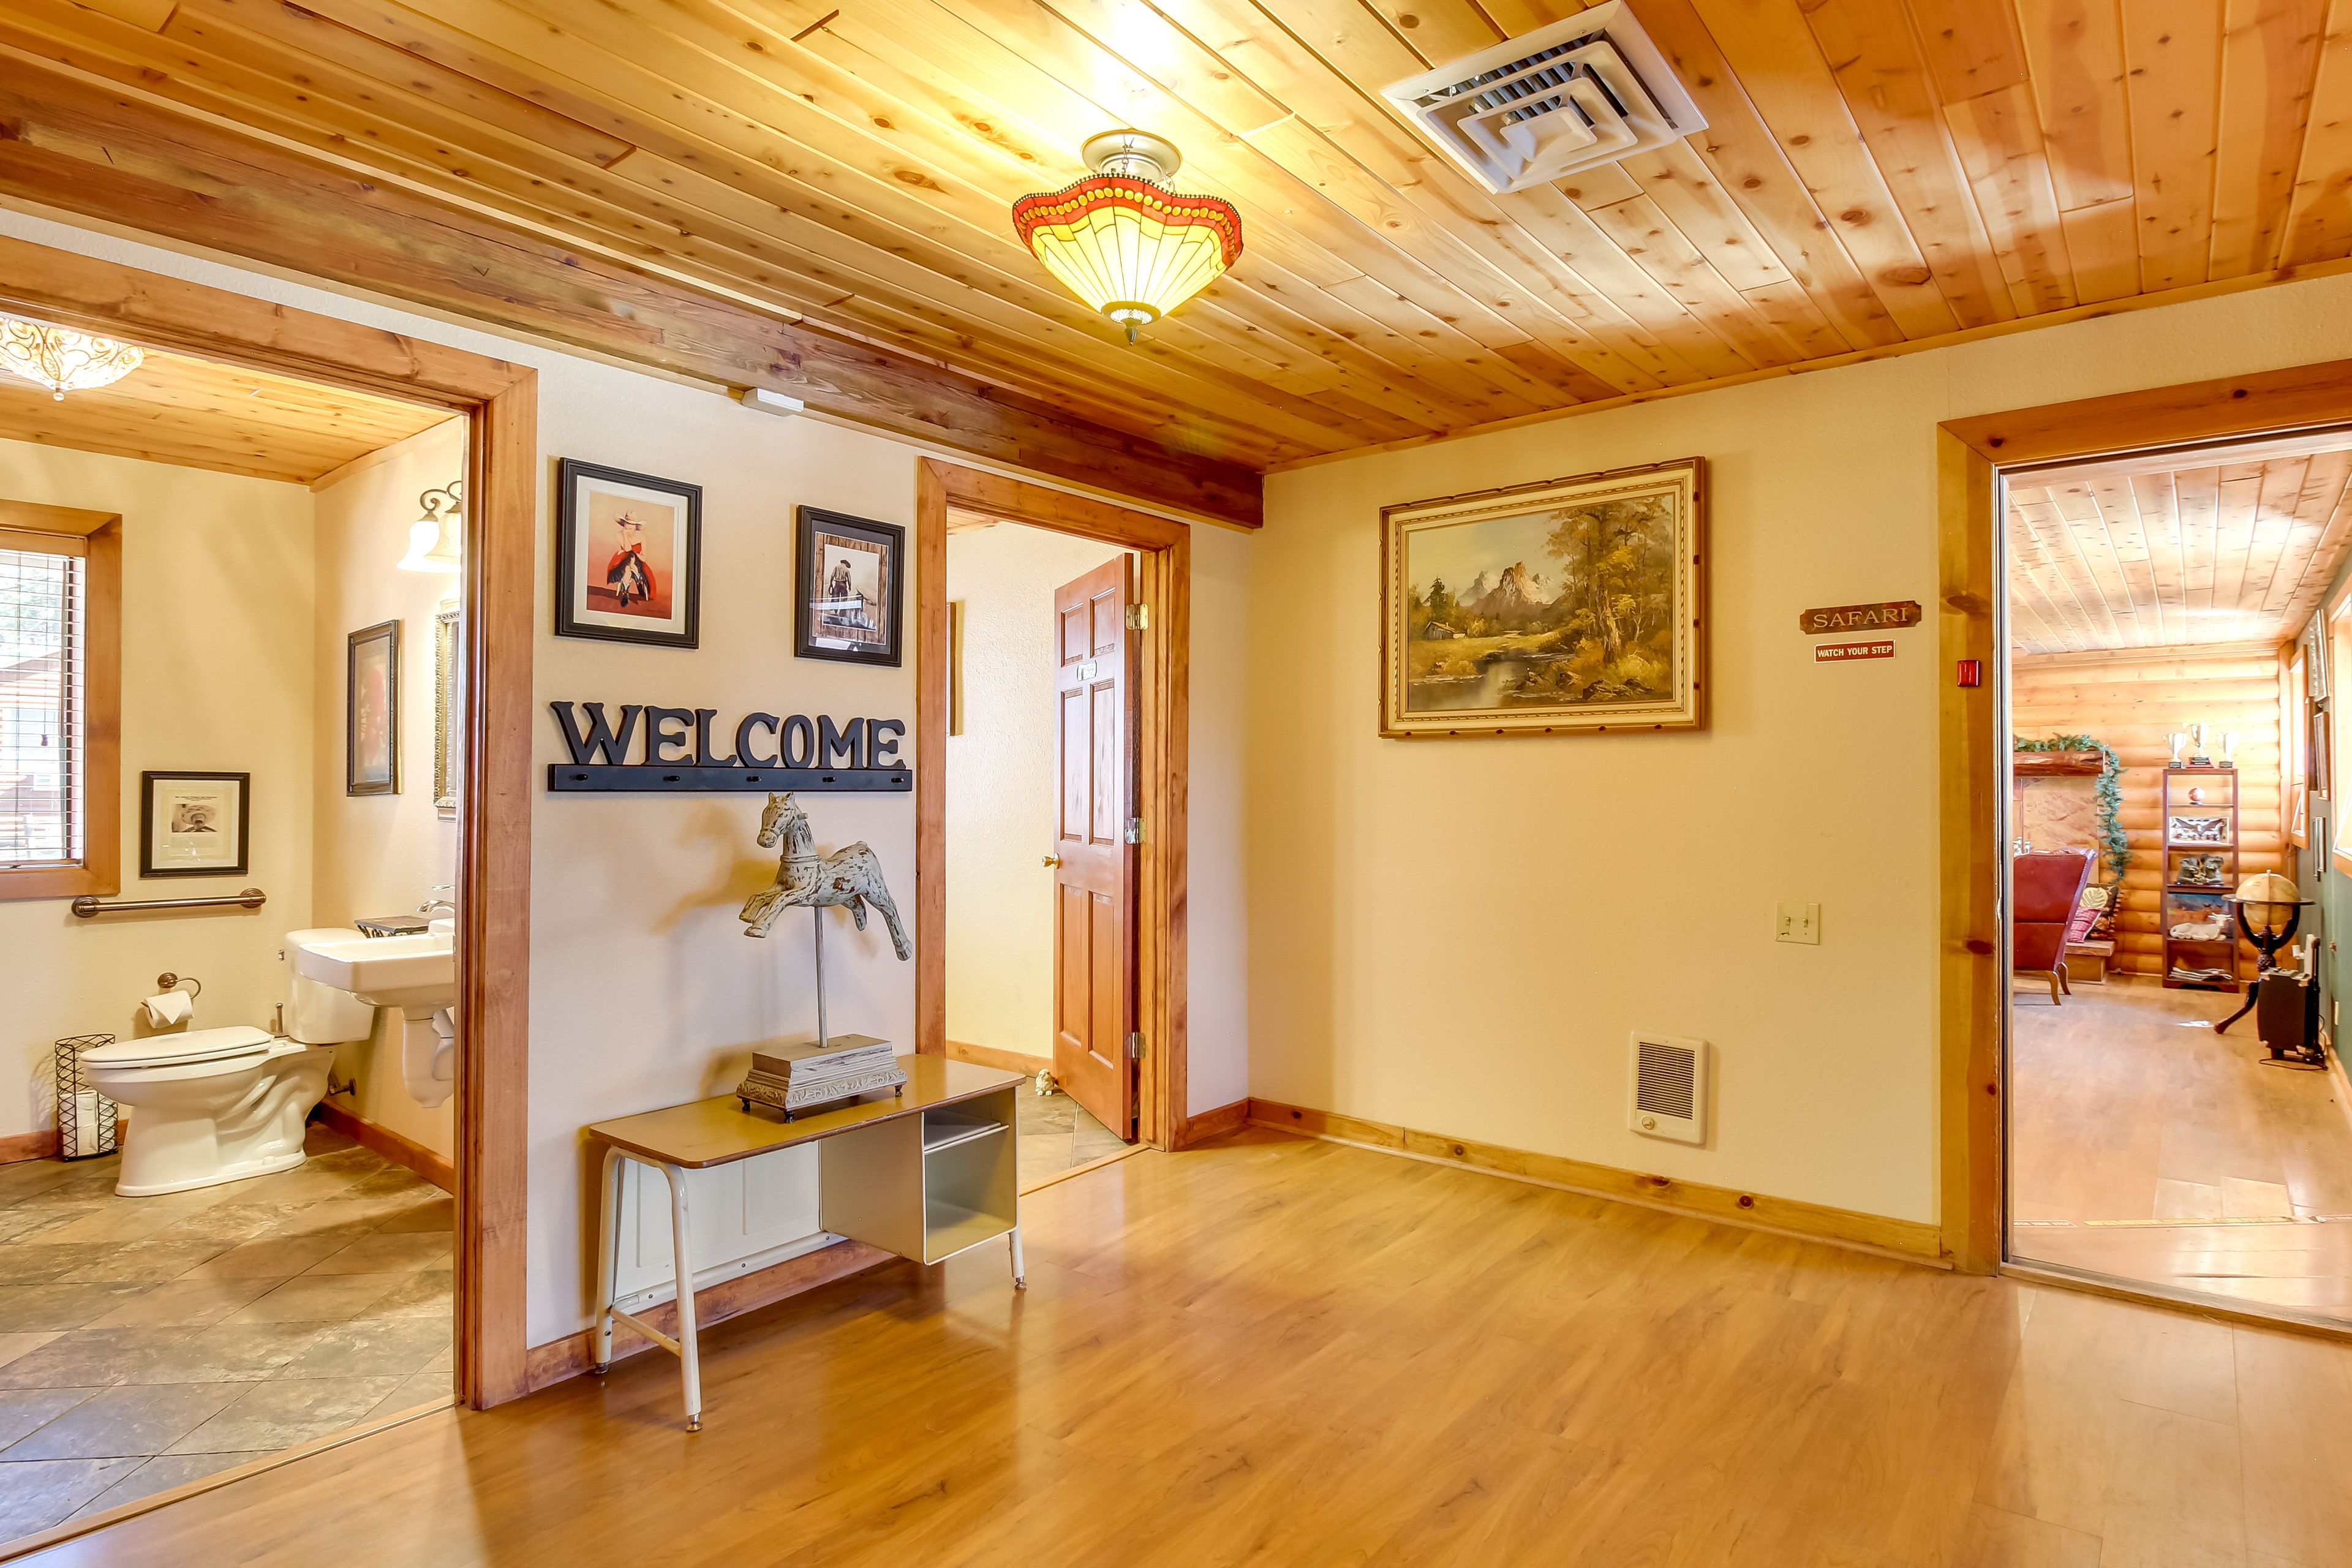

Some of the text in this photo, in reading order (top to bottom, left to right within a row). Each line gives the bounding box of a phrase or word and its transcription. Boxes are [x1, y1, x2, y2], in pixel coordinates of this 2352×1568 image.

[1813, 608, 1908, 628] SAFARI
[1817, 645, 1893, 657] WATCH YOUR STEP
[550, 701, 907, 769] WELCOME
